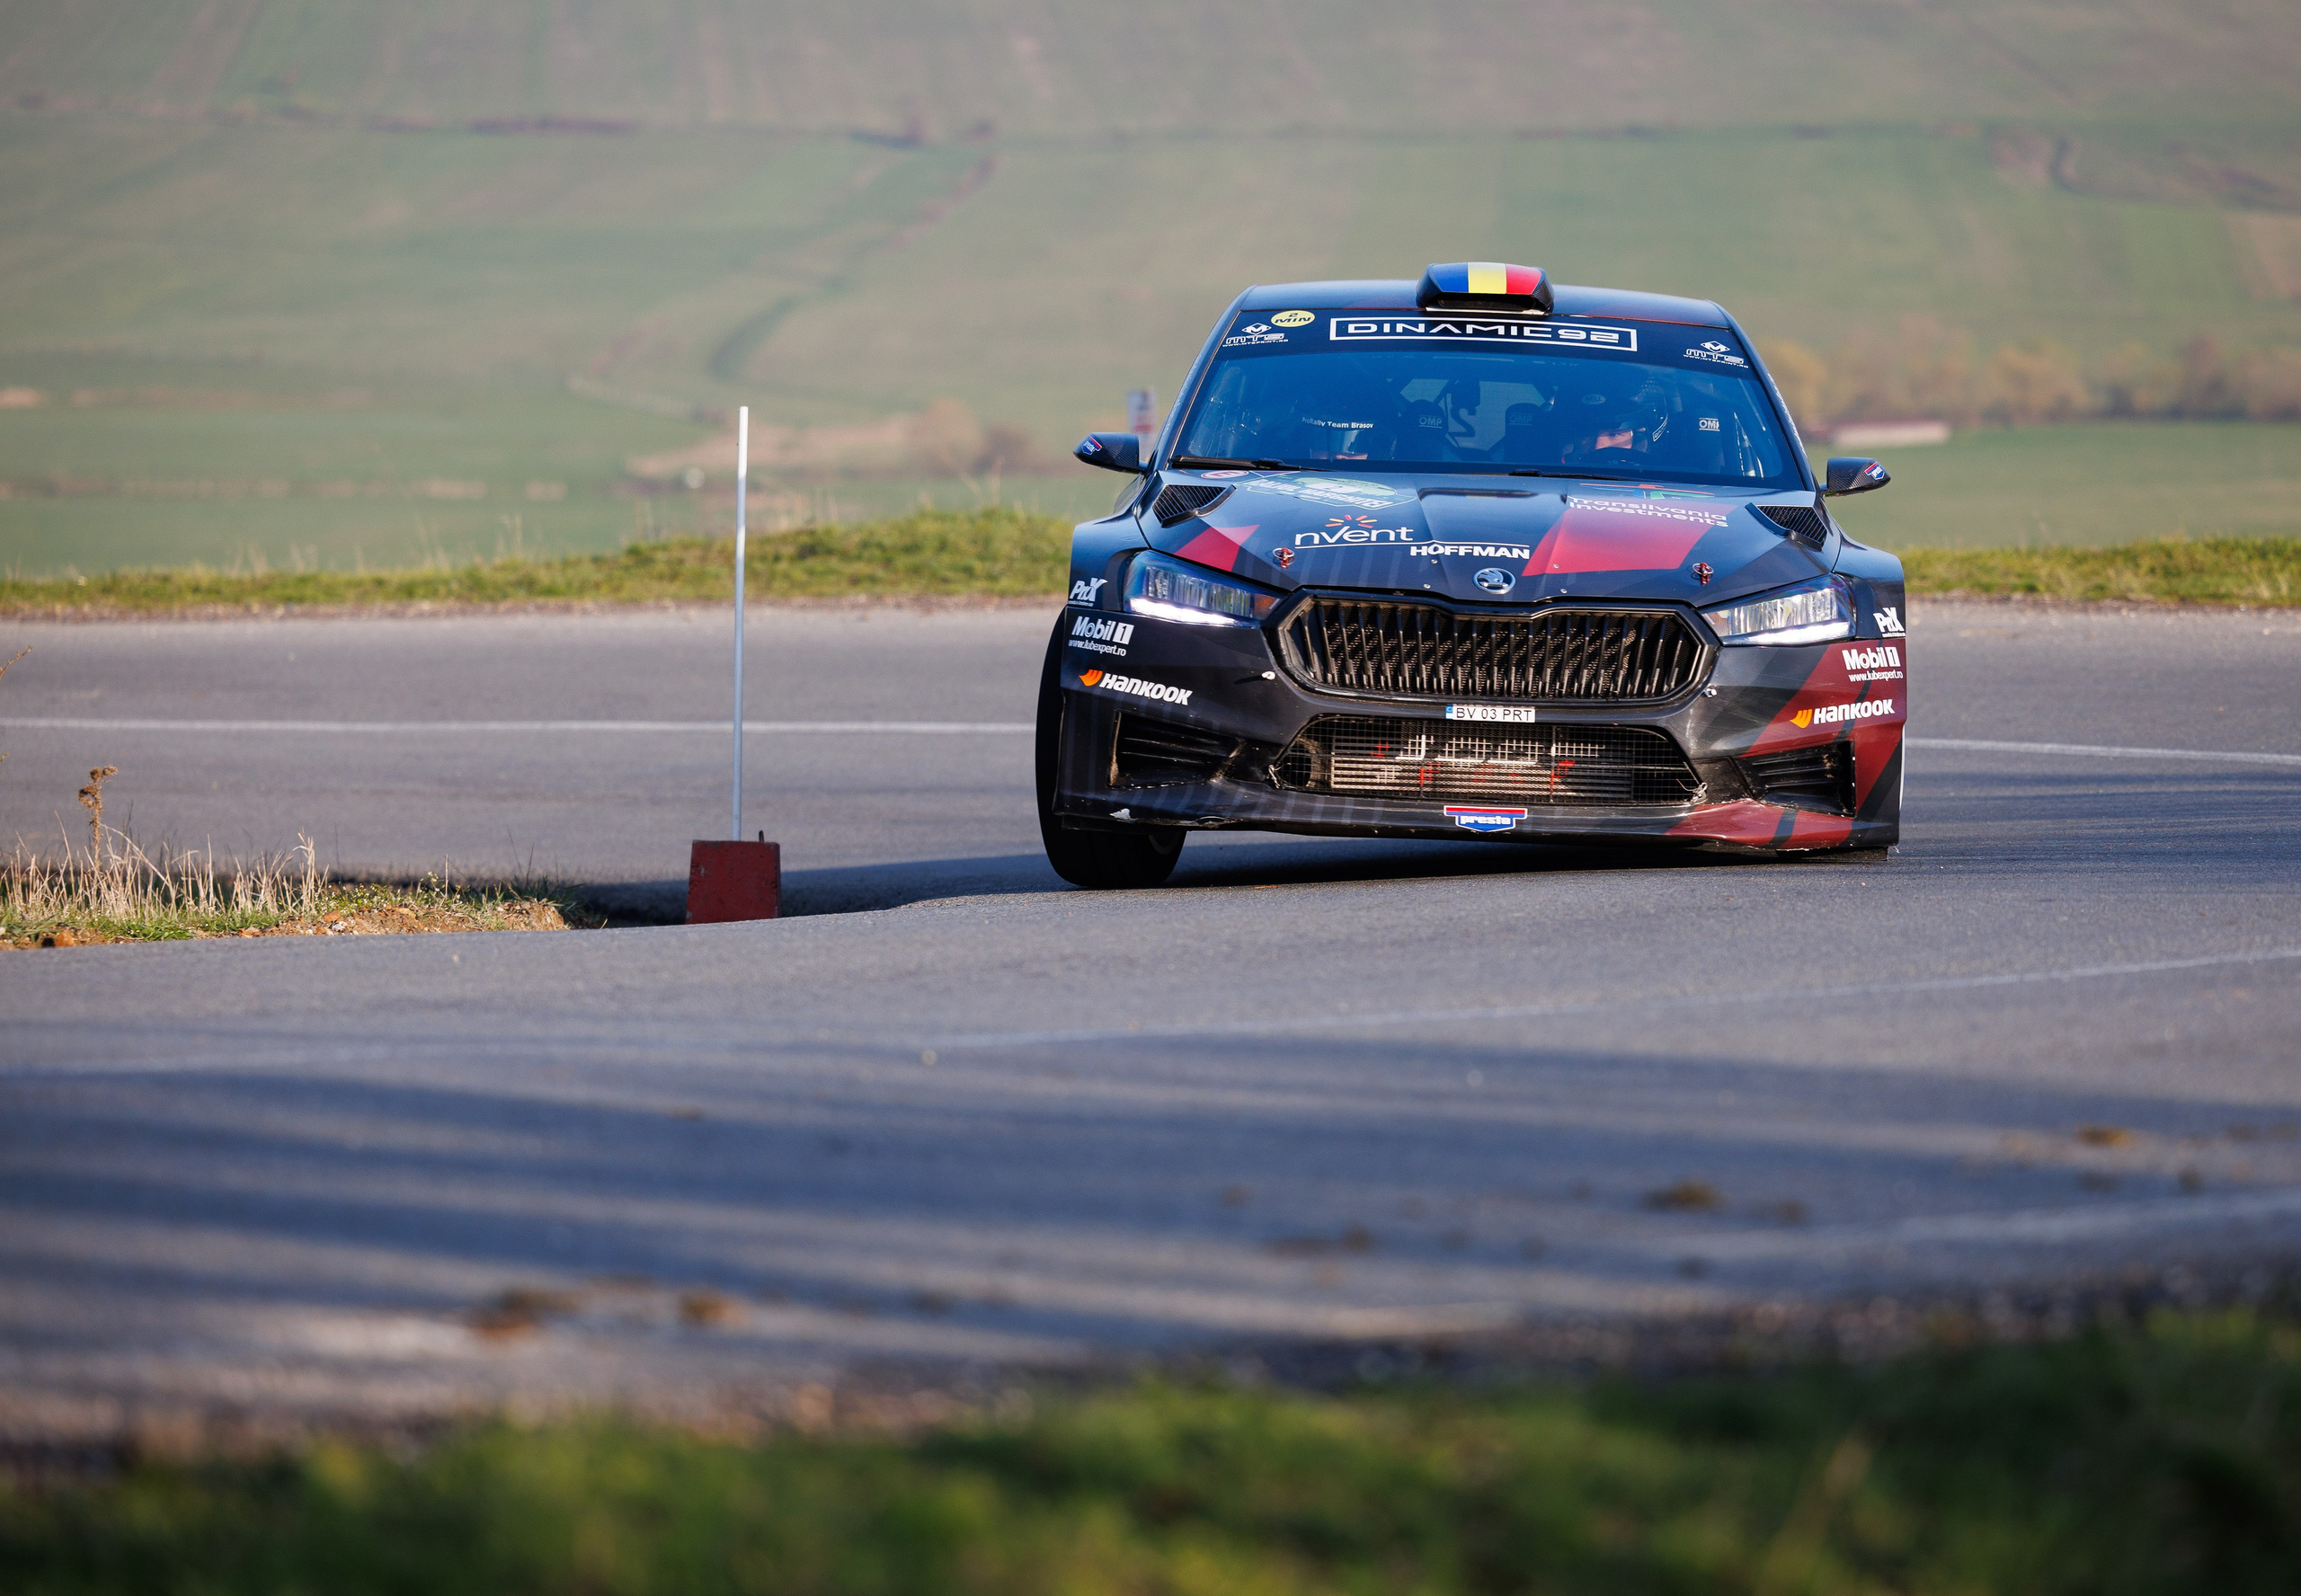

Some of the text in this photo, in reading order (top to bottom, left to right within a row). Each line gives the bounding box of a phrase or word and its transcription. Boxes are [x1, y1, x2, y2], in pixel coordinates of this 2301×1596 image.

[1274, 316, 1312, 324] MIN
[1347, 321, 1620, 344] DINAMIC92
[1327, 421, 1349, 429] Team
[1351, 421, 1374, 430] Brasov
[1418, 416, 1443, 426] OMP
[1568, 495, 1728, 521] Transilvania
[1568, 501, 1729, 528] Investments
[1409, 543, 1530, 560] HOFFMAN
[1071, 616, 1116, 641] Mobil
[1068, 639, 1127, 657] www.lubexpert.ro
[1842, 647, 1888, 670] Mobil
[1848, 669, 1904, 682] www.lubexpert.ro
[1456, 707, 1533, 721] BV 03 PRT
[1460, 815, 1511, 825] presto
